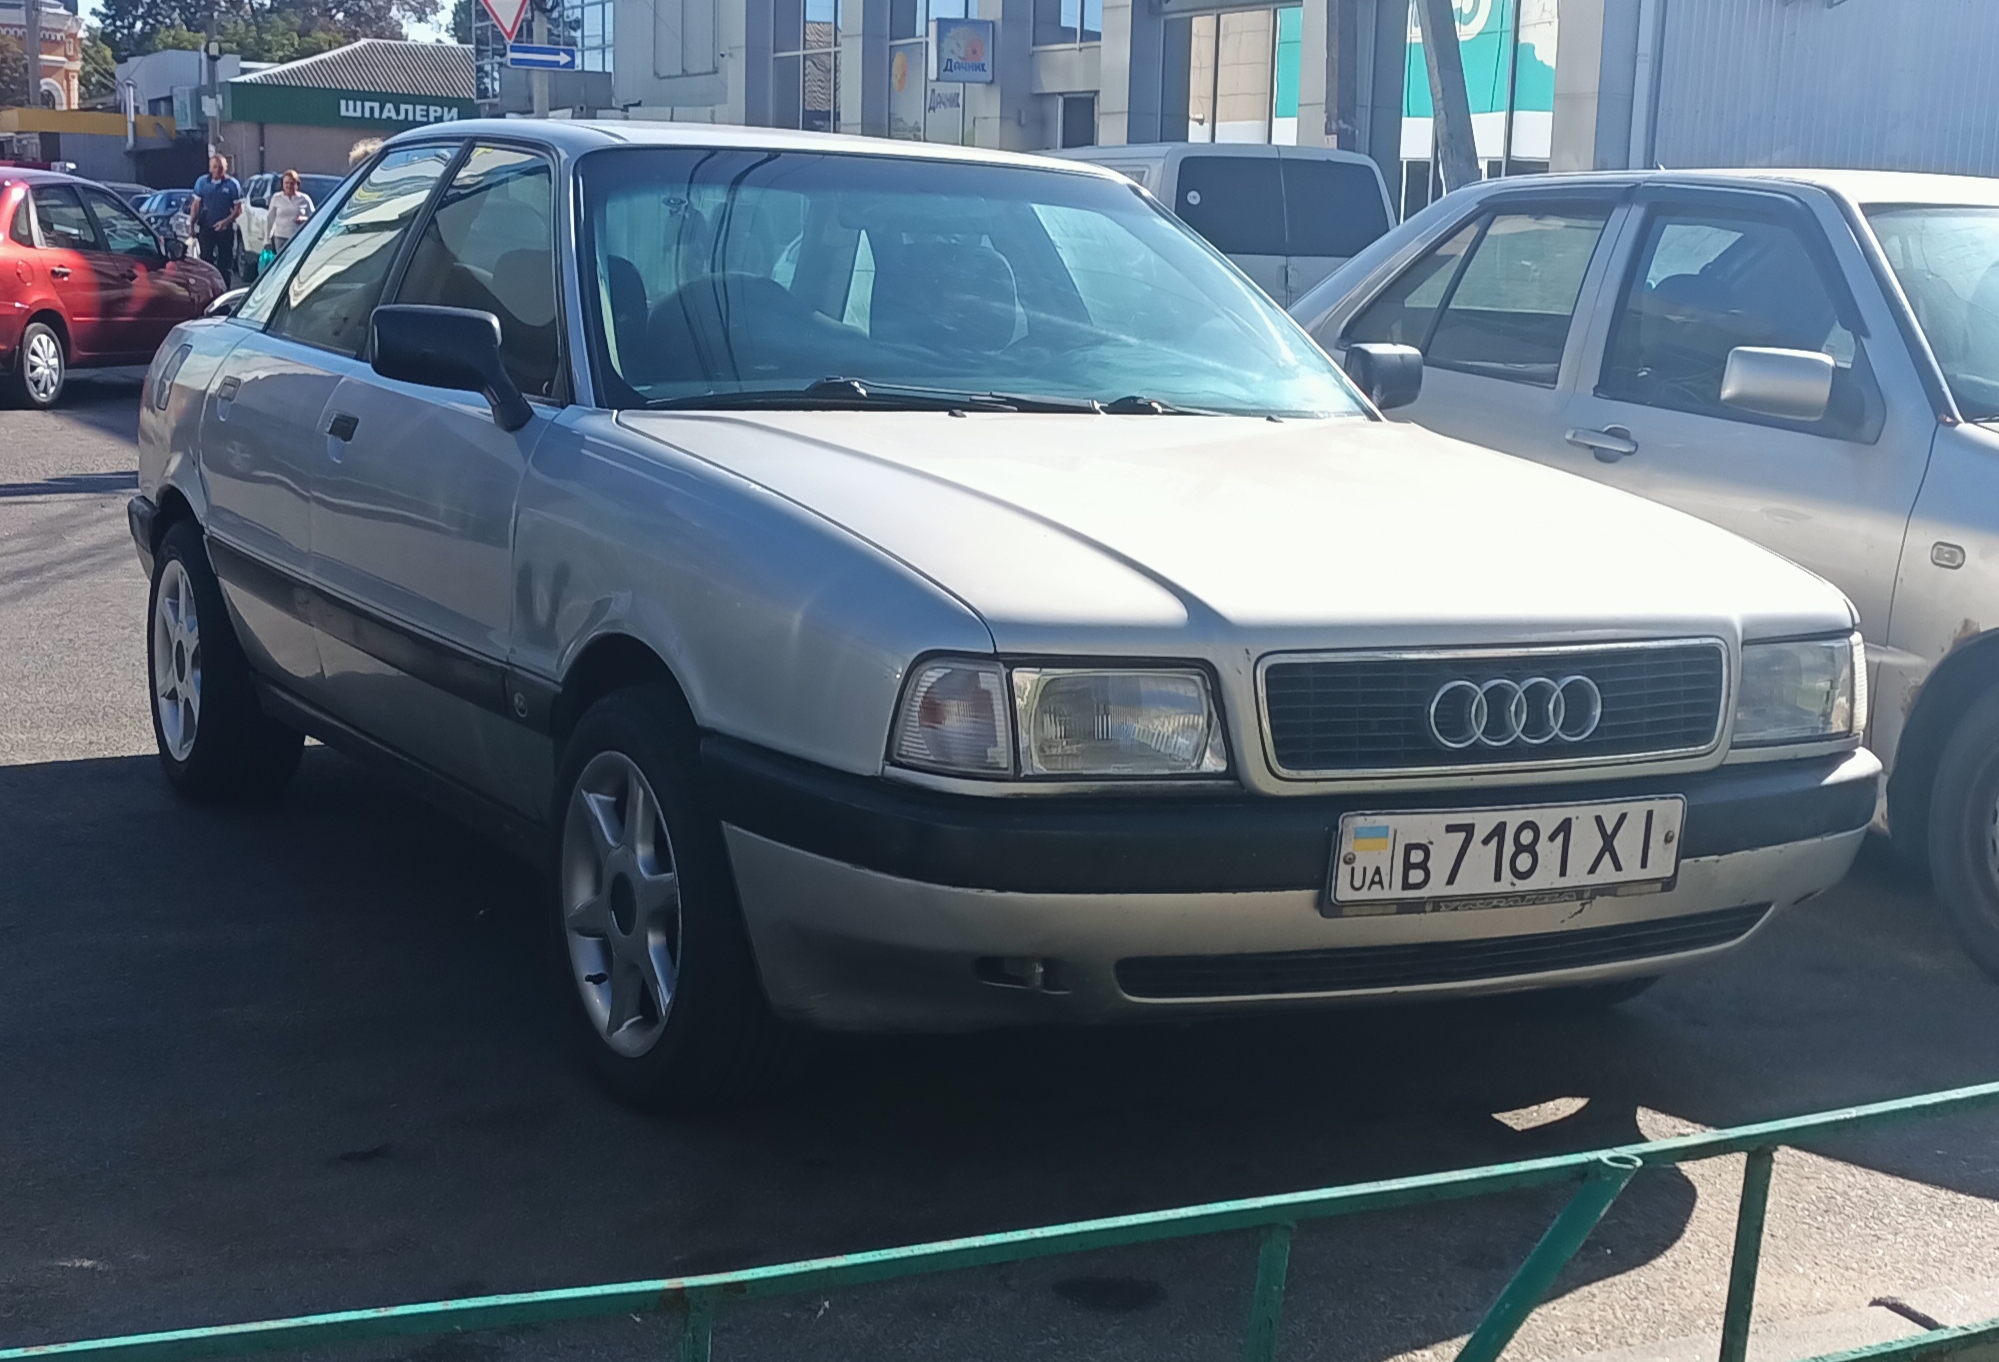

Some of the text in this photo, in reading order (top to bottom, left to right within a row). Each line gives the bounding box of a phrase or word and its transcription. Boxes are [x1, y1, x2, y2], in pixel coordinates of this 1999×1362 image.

[942, 58, 987, 73] Дачник
[340, 99, 459, 122] ШПАЛЕРИ
[1350, 865, 1385, 891] UA
